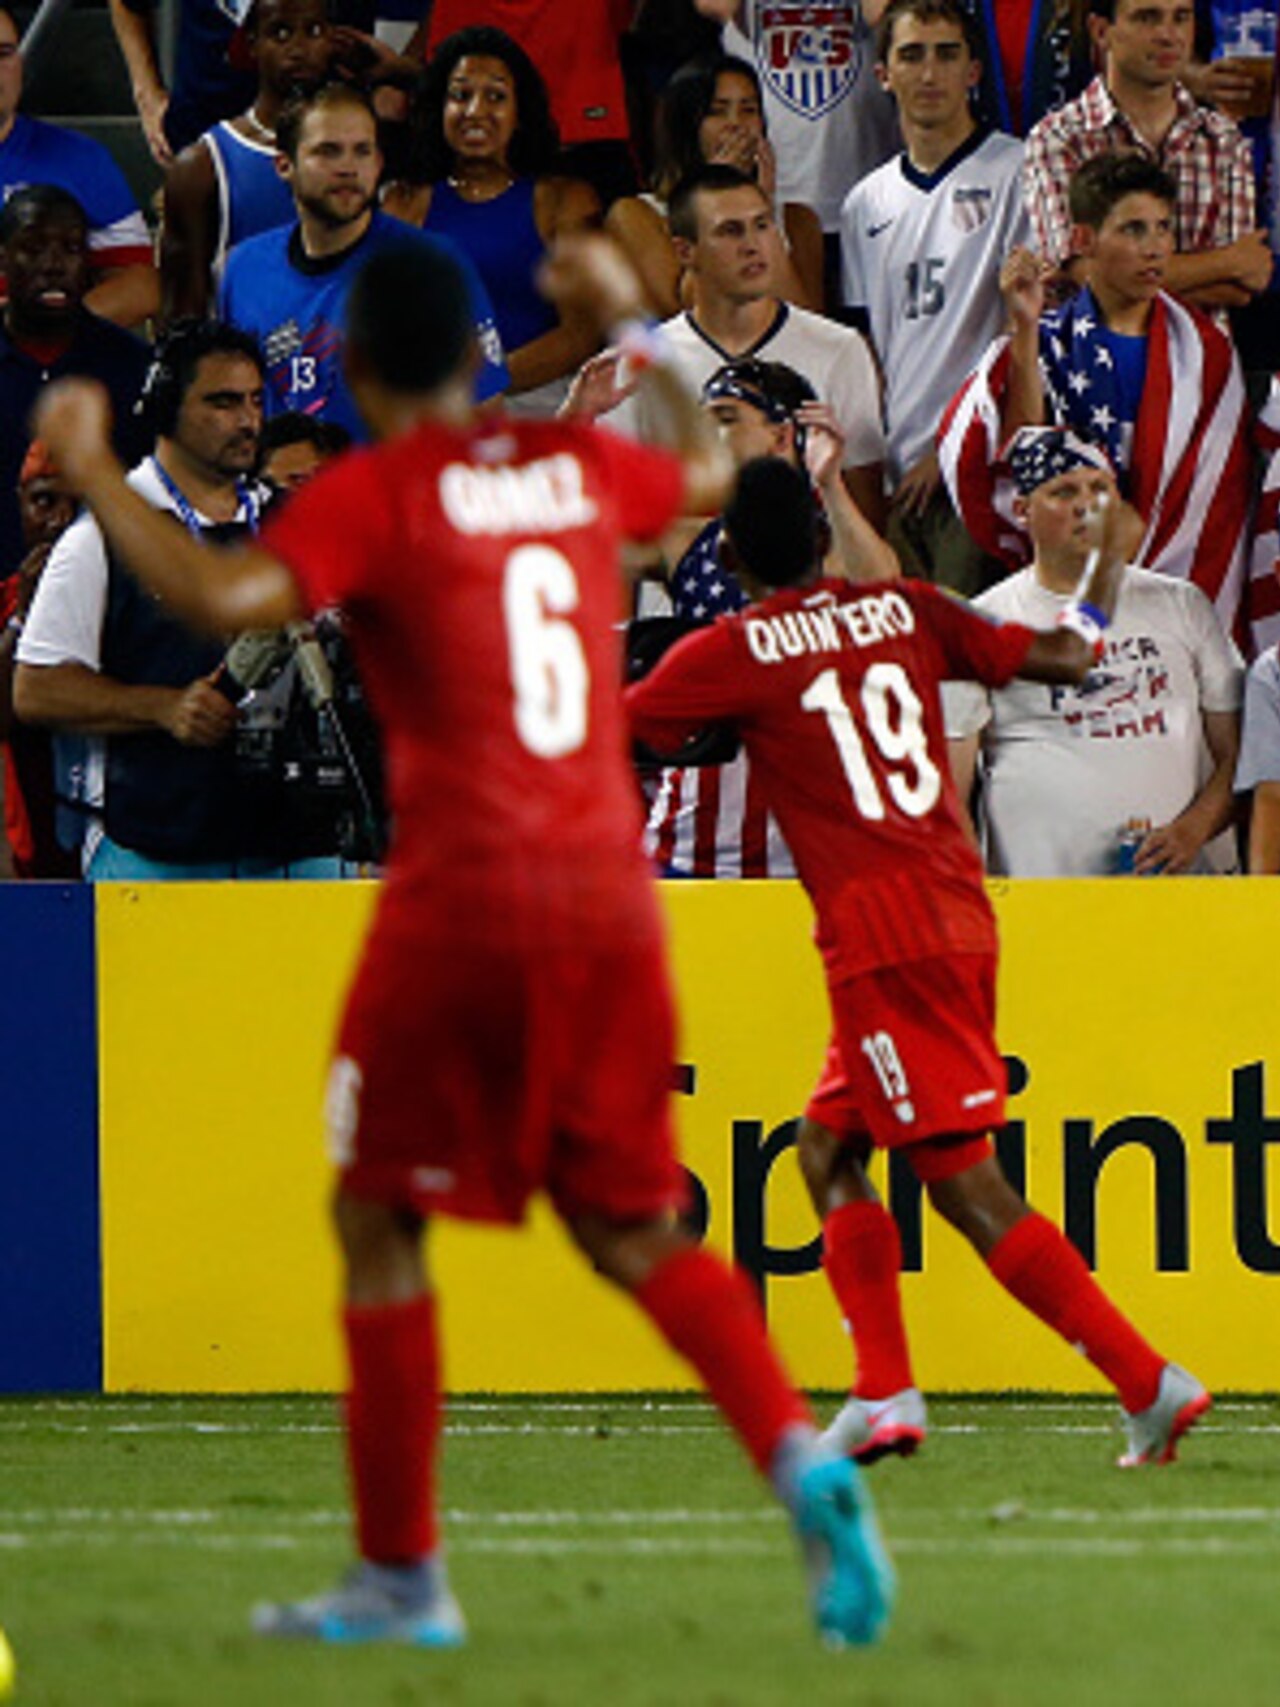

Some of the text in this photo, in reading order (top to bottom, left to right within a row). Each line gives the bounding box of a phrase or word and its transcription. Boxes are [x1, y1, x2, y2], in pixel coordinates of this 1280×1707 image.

[906, 258, 944, 320] 15
[290, 356, 317, 393] 13
[503, 543, 589, 758] 6
[746, 590, 914, 664] QUINERO
[801, 663, 941, 821] 19
